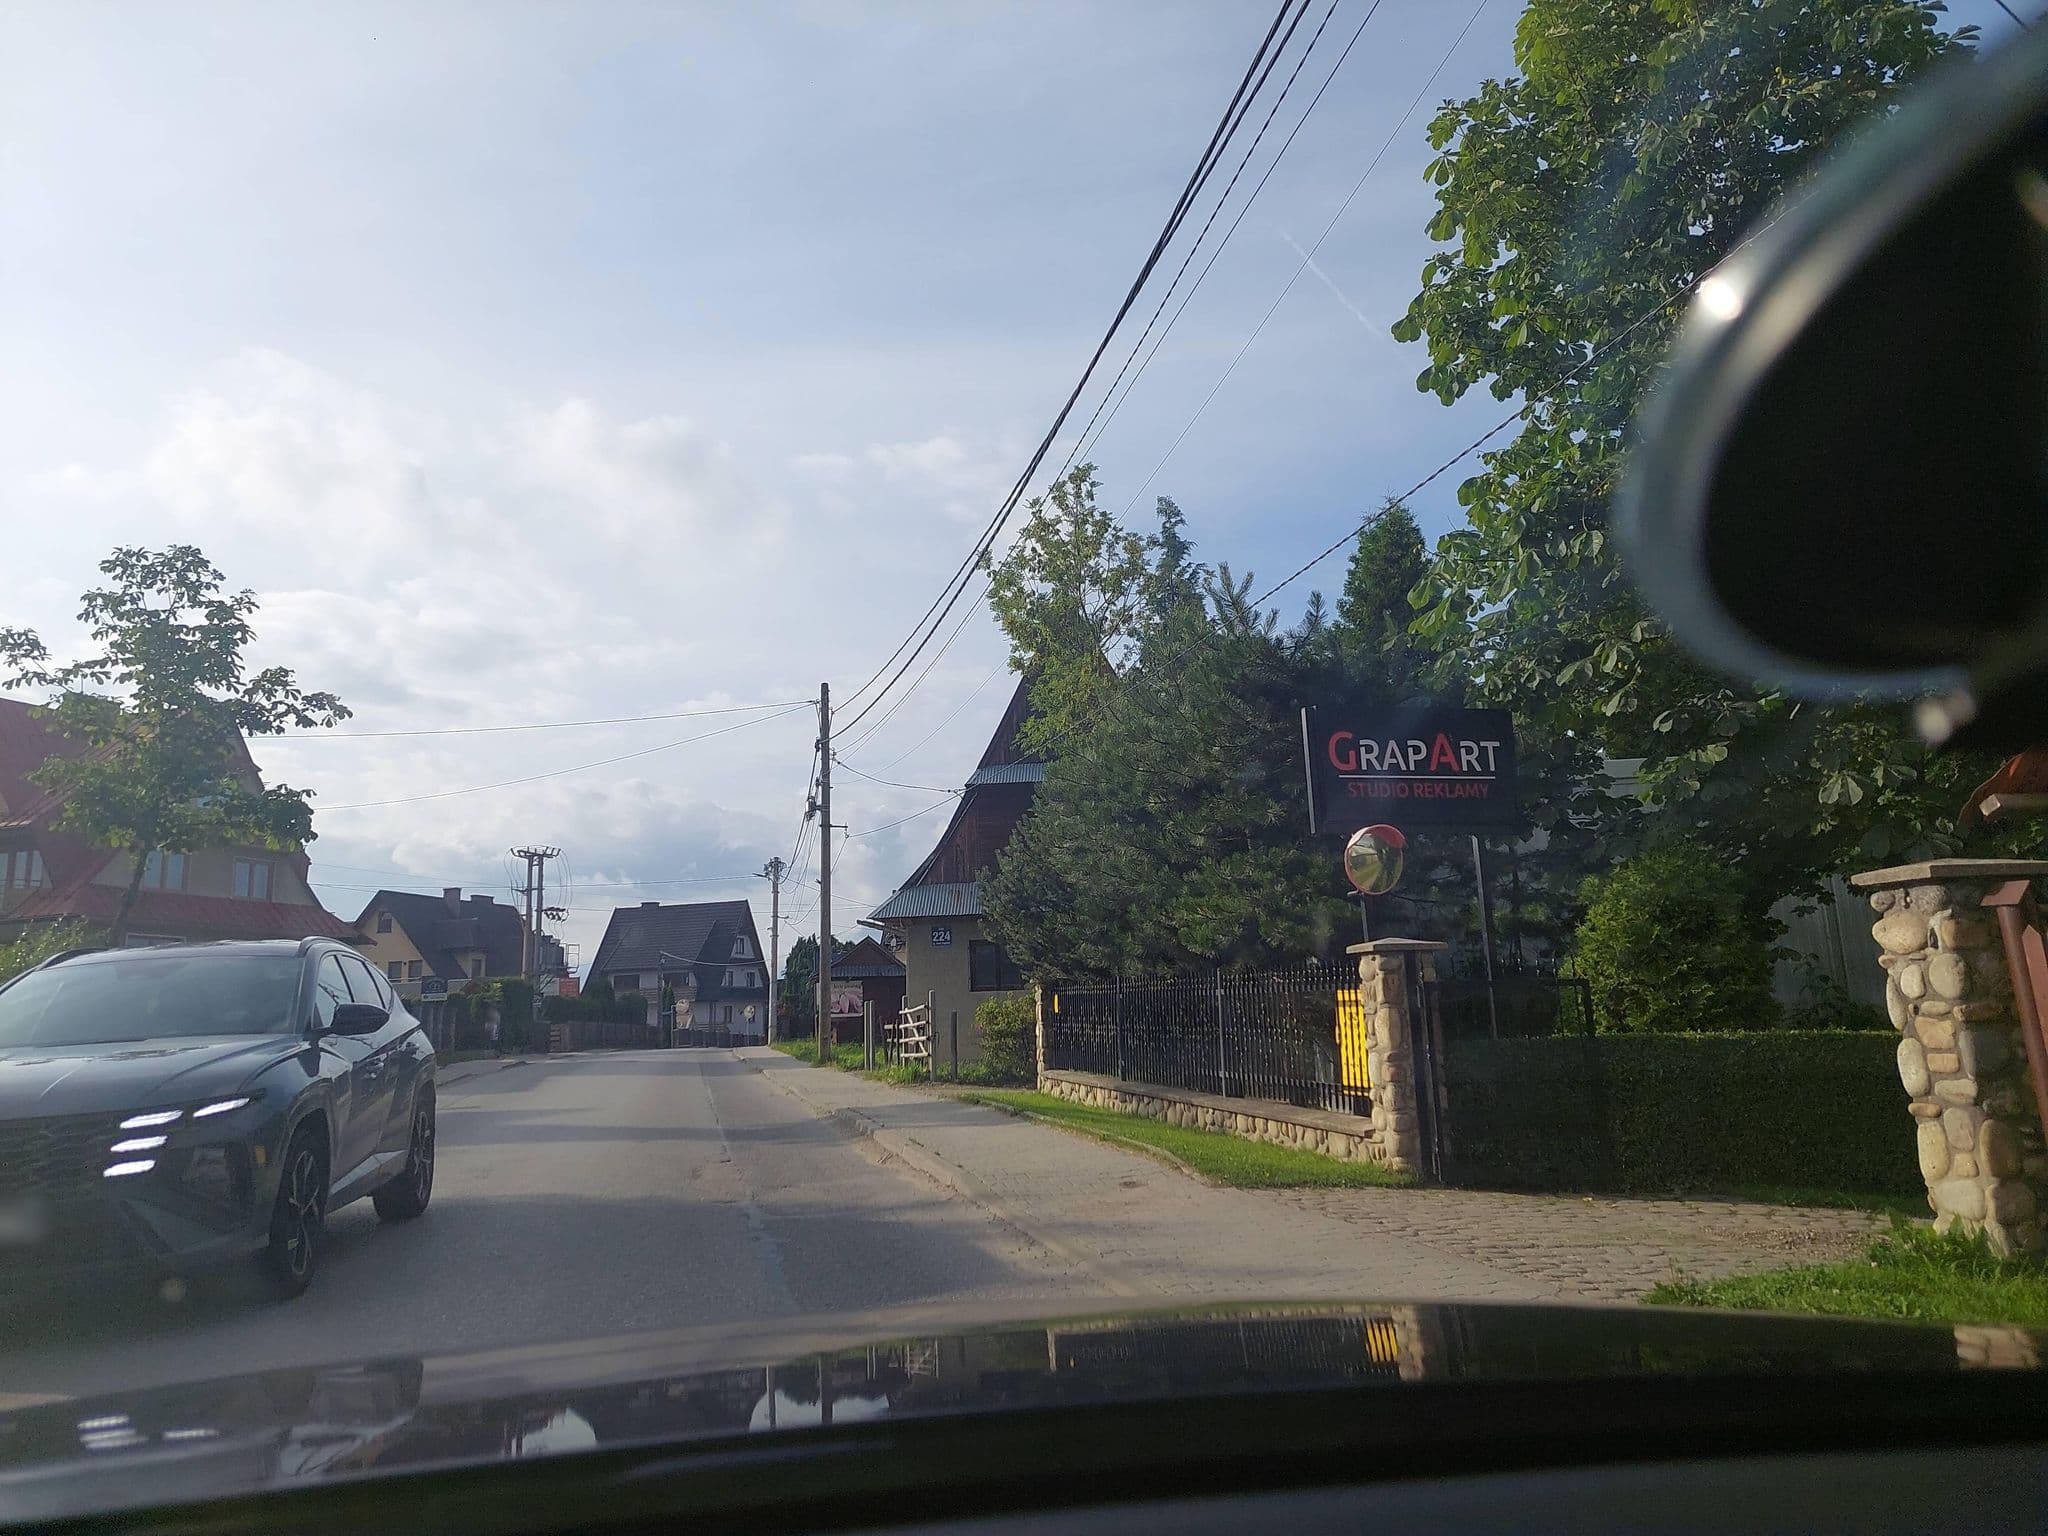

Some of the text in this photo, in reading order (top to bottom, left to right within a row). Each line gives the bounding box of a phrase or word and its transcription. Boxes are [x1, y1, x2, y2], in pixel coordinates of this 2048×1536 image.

[1328, 731, 1500, 772] GRAPART
[1348, 782, 1489, 799] STUDIO REKLAMY
[932, 931, 951, 941] 224
